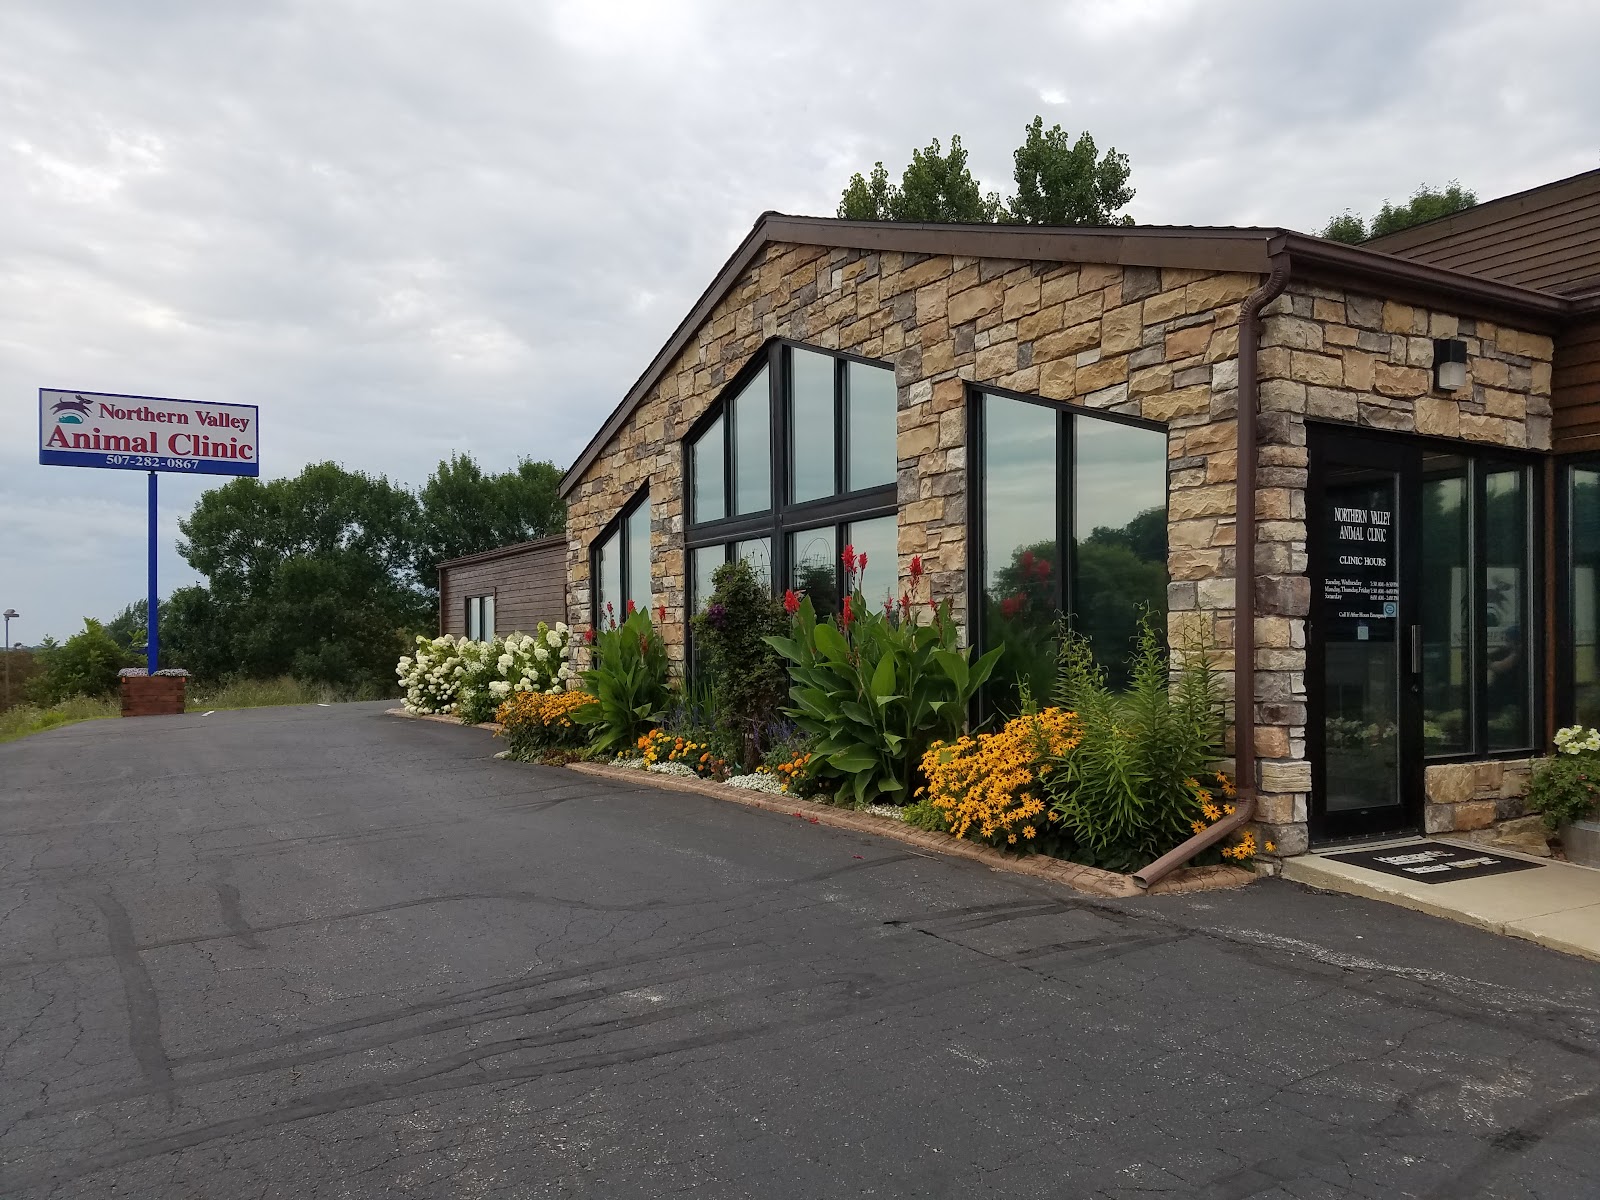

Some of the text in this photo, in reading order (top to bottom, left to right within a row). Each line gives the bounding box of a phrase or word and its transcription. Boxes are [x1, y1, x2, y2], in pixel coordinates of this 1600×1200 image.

[98, 402, 250, 433] Northern Valley
[45, 424, 253, 460] Animal Clinic
[105, 454, 200, 470] 507-282-0867
[1334, 506, 1391, 526] NORTHERN VALLEY
[1339, 525, 1387, 543] ANIMAL CLINIC
[1339, 555, 1387, 567] CLINIC HOURS
